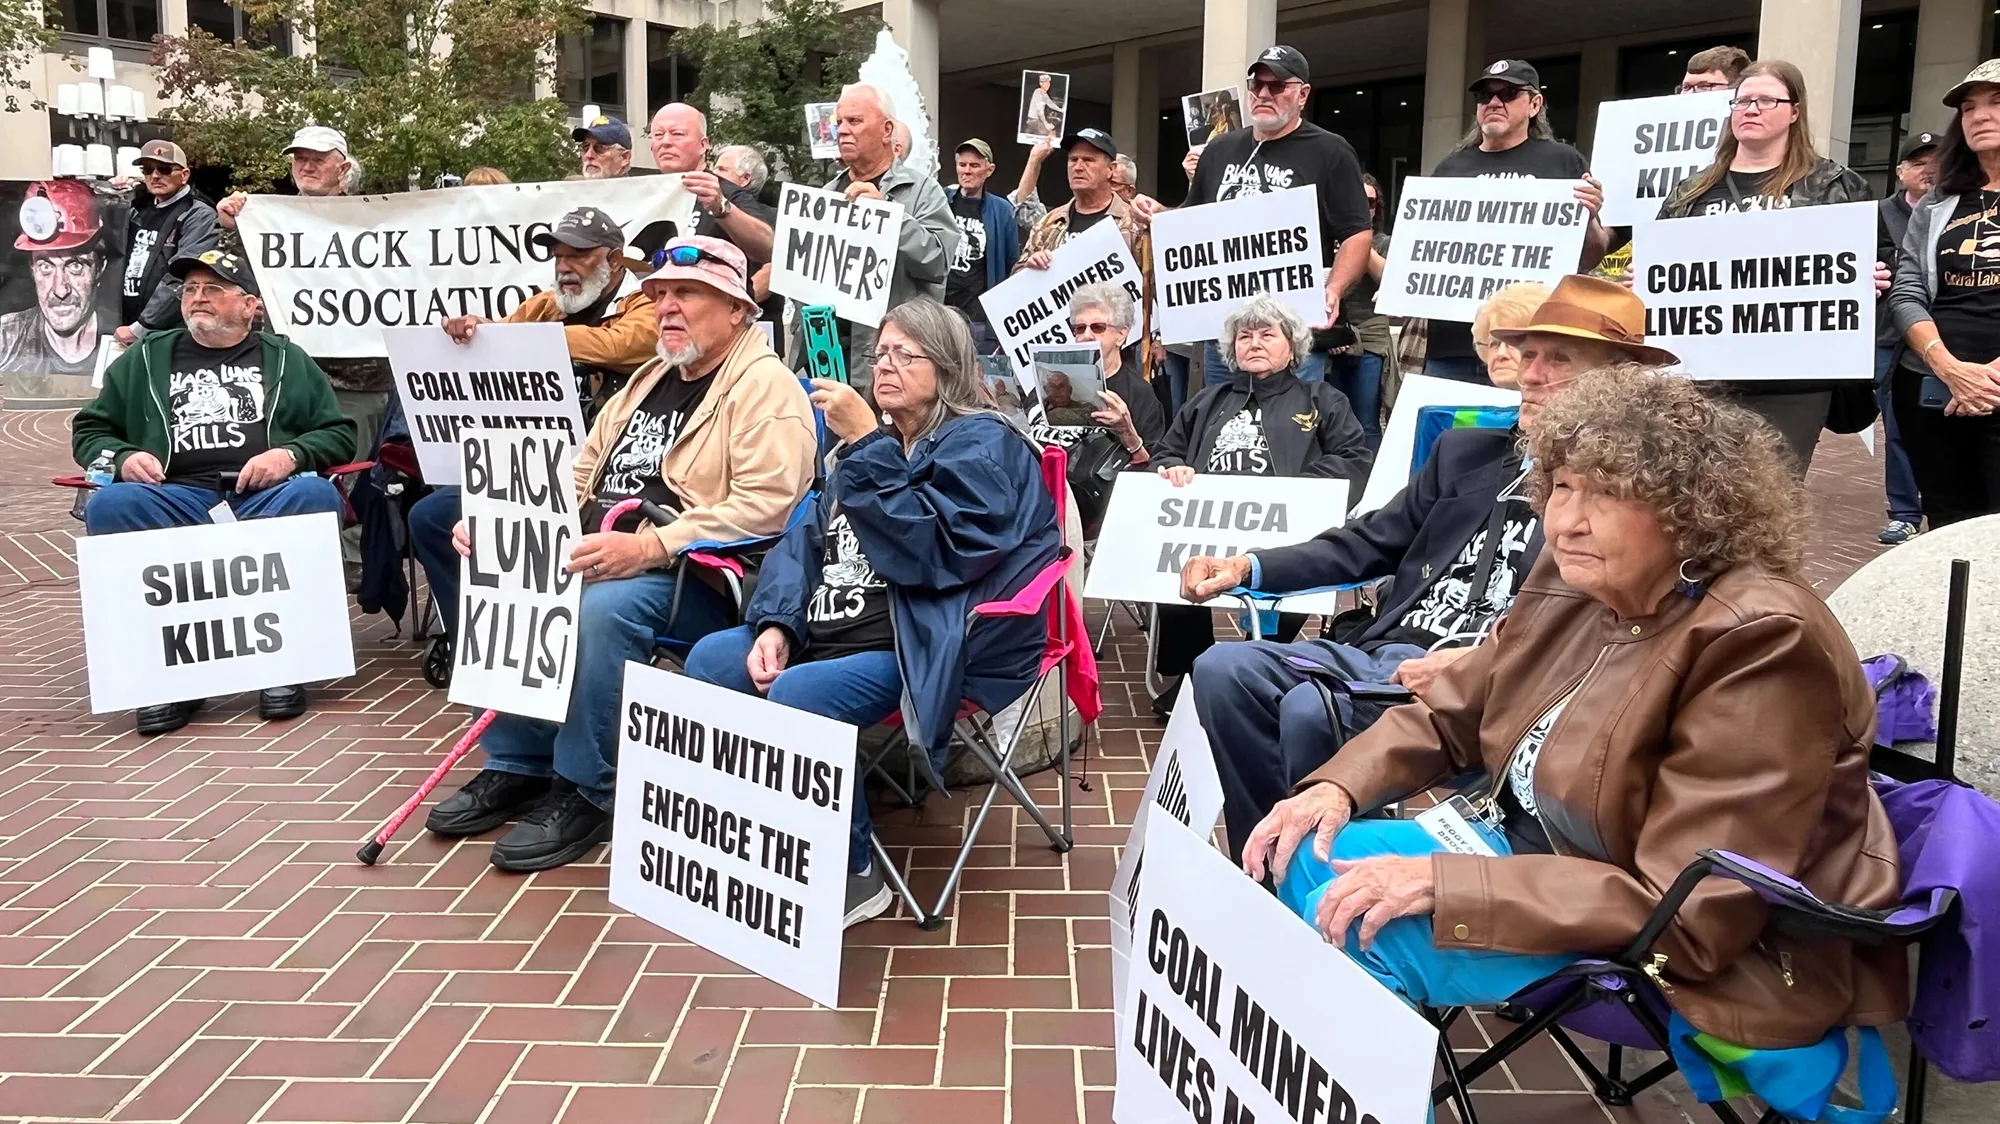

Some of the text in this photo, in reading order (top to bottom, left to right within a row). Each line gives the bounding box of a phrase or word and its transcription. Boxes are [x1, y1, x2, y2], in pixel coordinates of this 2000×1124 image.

[1264, 163, 1294, 188] LUNG
[784, 189, 891, 234] PROTECT
[1403, 198, 1584, 227] STAND WITH US!
[259, 230, 412, 269] BLACK
[1164, 226, 1309, 272] COAL MINERS
[1410, 239, 1553, 269] ENFORCE THE
[1166, 276, 1222, 307] LIVES
[1227, 263, 1314, 299] MATTER
[1405, 272, 1473, 299] SILICA
[1647, 251, 1857, 294] COAL MINERS
[1003, 296, 1053, 338] COAL
[1645, 299, 1859, 337] LIVES MATTER
[220, 364, 263, 383] LUNG
[406, 370, 565, 402] COAL MINERS
[173, 423, 246, 454] KILLS
[463, 436, 568, 514] BLACK
[1157, 498, 1288, 532] SILICA
[468, 516, 574, 595] LUNG
[142, 552, 291, 606] SILICA
[162, 612, 283, 667] KILLS
[461, 595, 572, 690] KILLS!
[627, 701, 843, 812] STAND WITH US!
[642, 780, 811, 885] ENFORCE THE
[640, 840, 804, 949] SILICA RULE!
[1148, 908, 1384, 1124] COAL MINER
[1134, 988, 1216, 1124] LIVES
